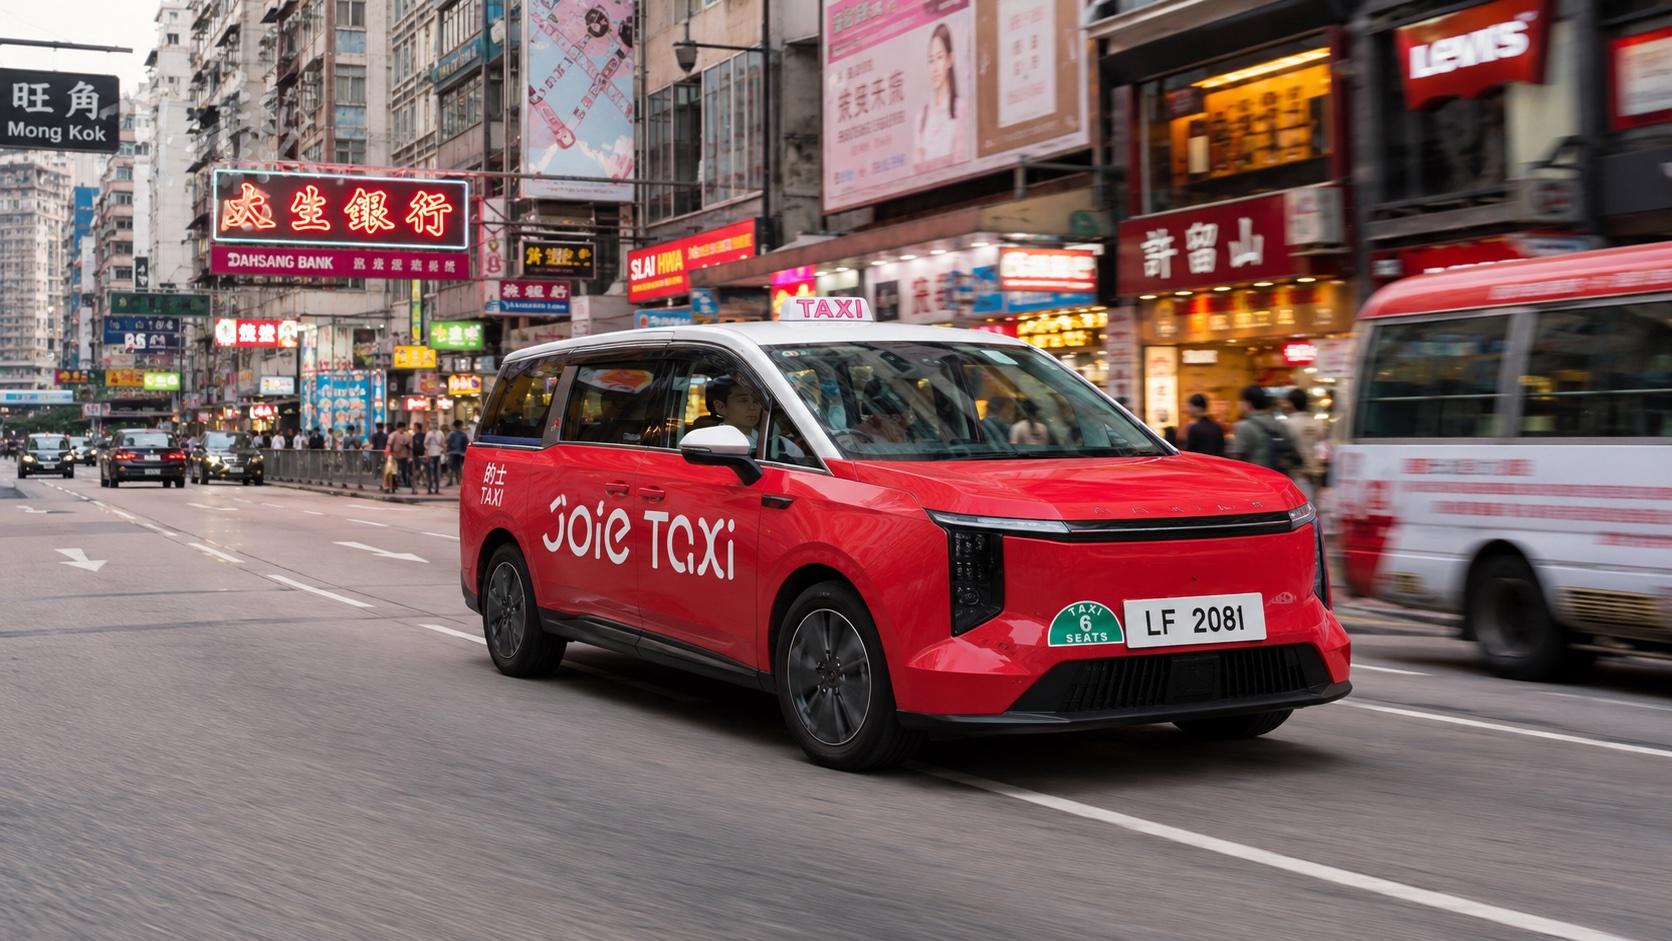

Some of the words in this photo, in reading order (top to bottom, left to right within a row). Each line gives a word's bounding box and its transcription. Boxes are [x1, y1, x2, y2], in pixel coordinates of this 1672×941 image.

[12, 81, 100, 120] 旺角
[8, 121, 62, 143] Mong
[69, 124, 106, 142] Kok
[1140, 217, 1265, 279] 許留山
[227, 252, 294, 268] DAHSANG
[298, 256, 334, 270] BANK
[797, 299, 863, 318] TAXI
[483, 462, 507, 485] 的士
[480, 486, 504, 508] TAXI
[542, 494, 631, 565] Joie
[1068, 604, 1103, 617] TAXI
[1145, 608, 1176, 636] LF
[1192, 605, 1245, 634] 2081
[1079, 614, 1092, 633] 6
[1066, 632, 1108, 643] SEATS
